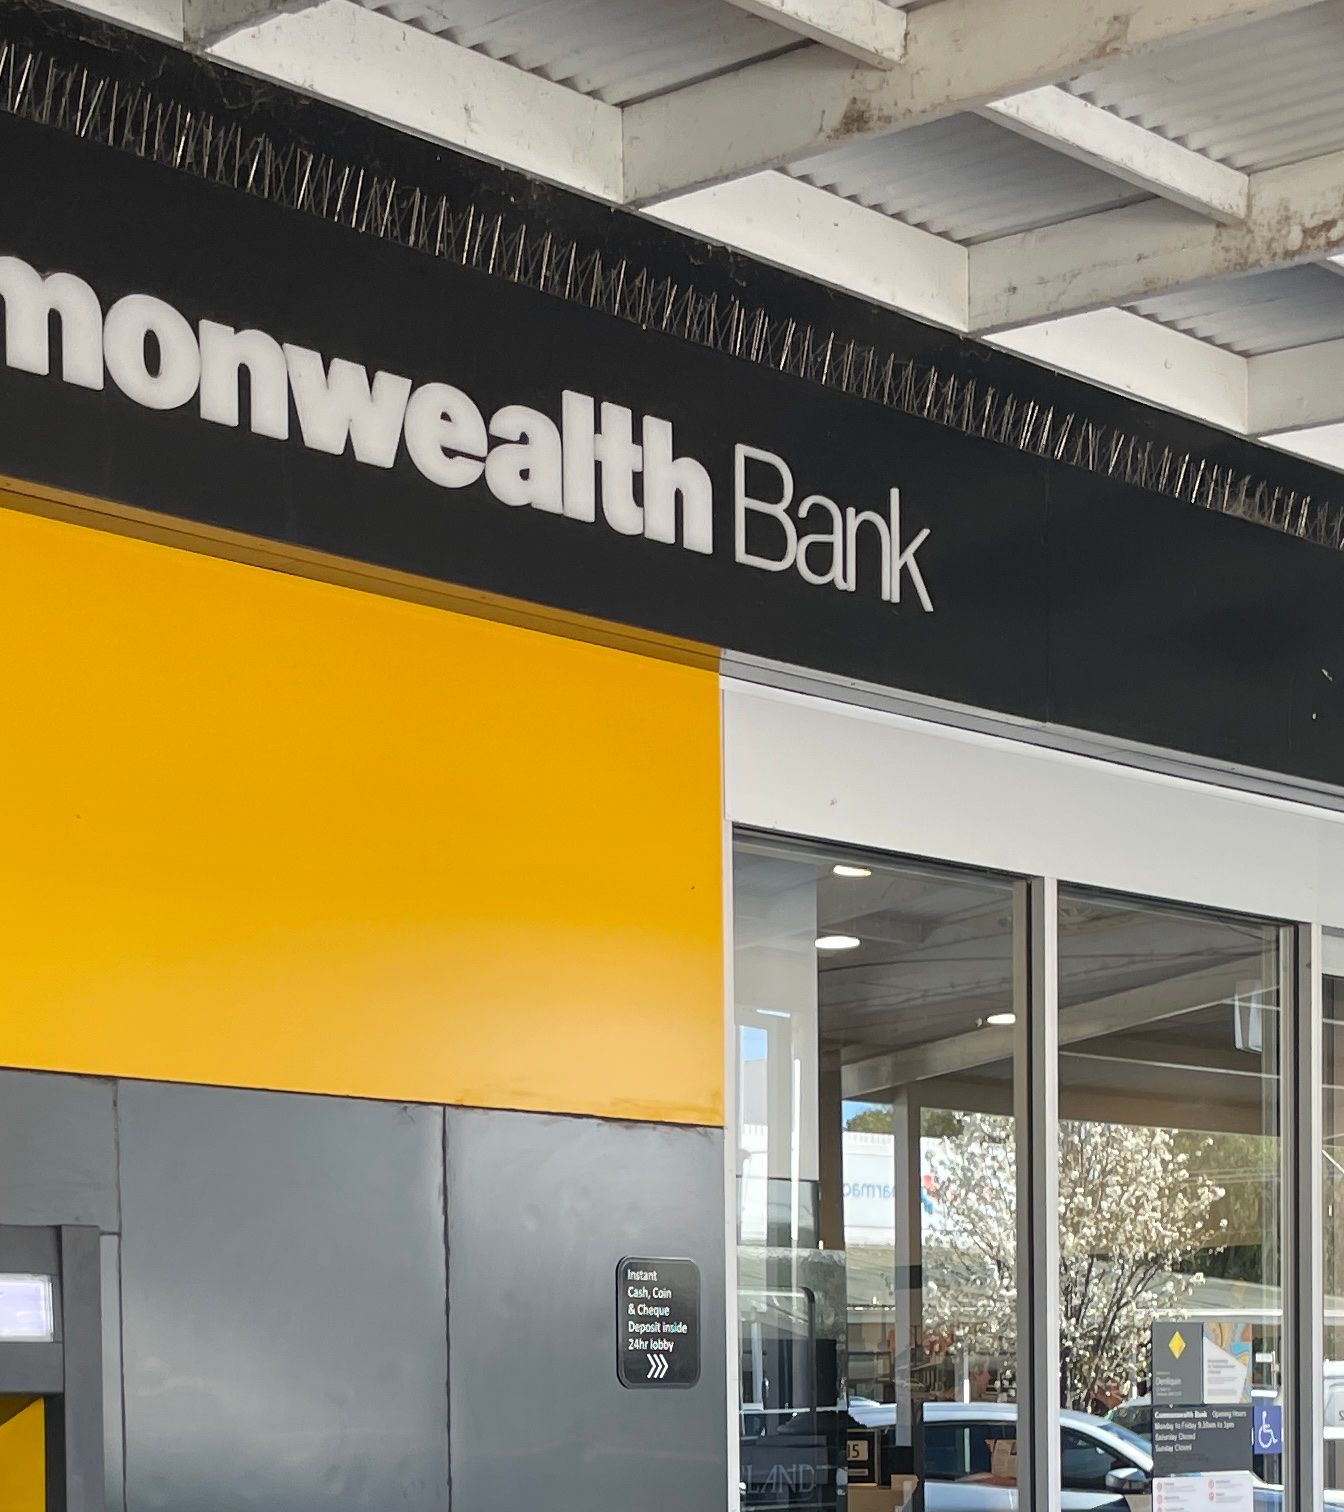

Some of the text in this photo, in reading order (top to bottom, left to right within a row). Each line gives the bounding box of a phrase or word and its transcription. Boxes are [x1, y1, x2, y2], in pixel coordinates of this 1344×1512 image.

[733, 442, 936, 613] Bank
[627, 1269, 658, 1282] Instant
[627, 1286, 672, 1300] Cash, Coin
[627, 1303, 670, 1318] & Cheque
[628, 1321, 688, 1335] Deposit inside
[628, 1338, 674, 1352] 24hr lobby
